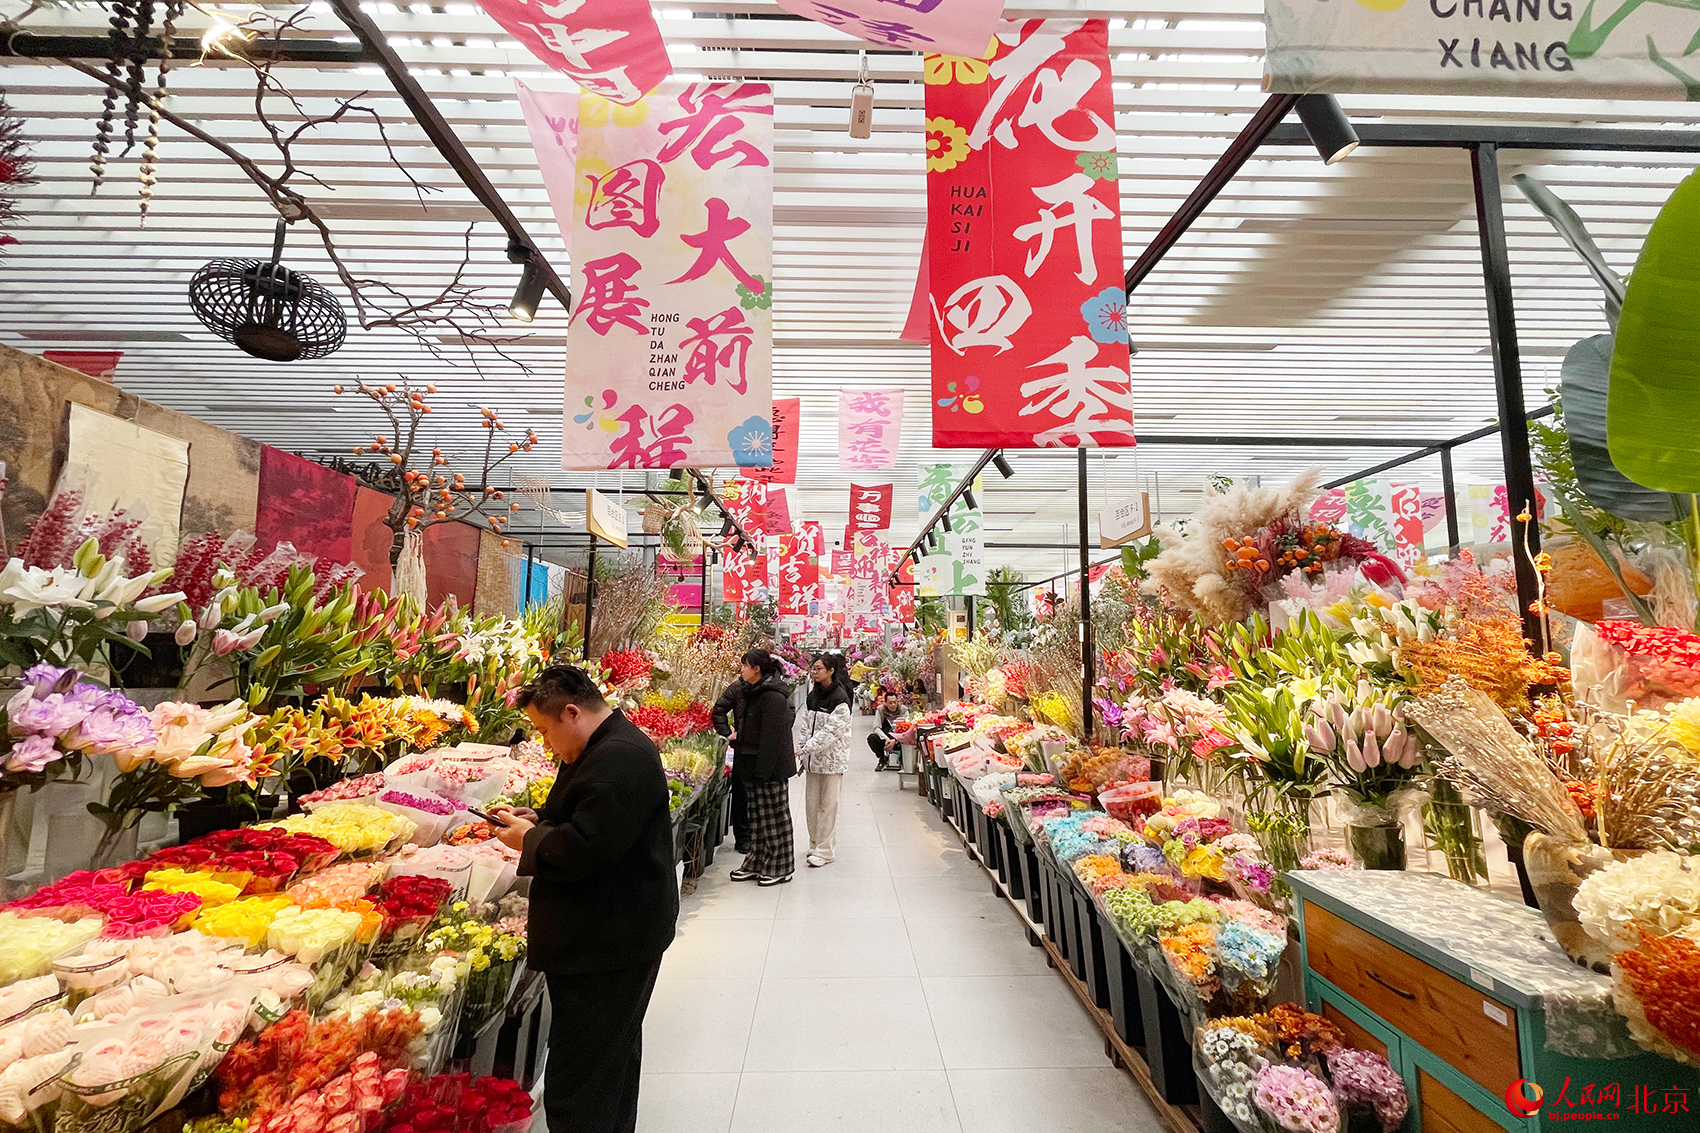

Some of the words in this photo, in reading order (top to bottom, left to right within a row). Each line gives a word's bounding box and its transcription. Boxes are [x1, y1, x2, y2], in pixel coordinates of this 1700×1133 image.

[1431, 0, 1573, 22] CHANG
[1438, 37, 1574, 72] XIANG
[950, 185, 987, 199] HUA
[950, 203, 983, 217] KAI
[950, 221, 971, 234] SI
[950, 239, 971, 252] JI
[650, 313, 680, 323] HONG
[650, 327, 665, 336] TU
[649, 340, 665, 350] DA
[649, 354, 679, 364] ZHAN
[648, 368, 677, 378] QIAN
[648, 381, 686, 391] CHENG
